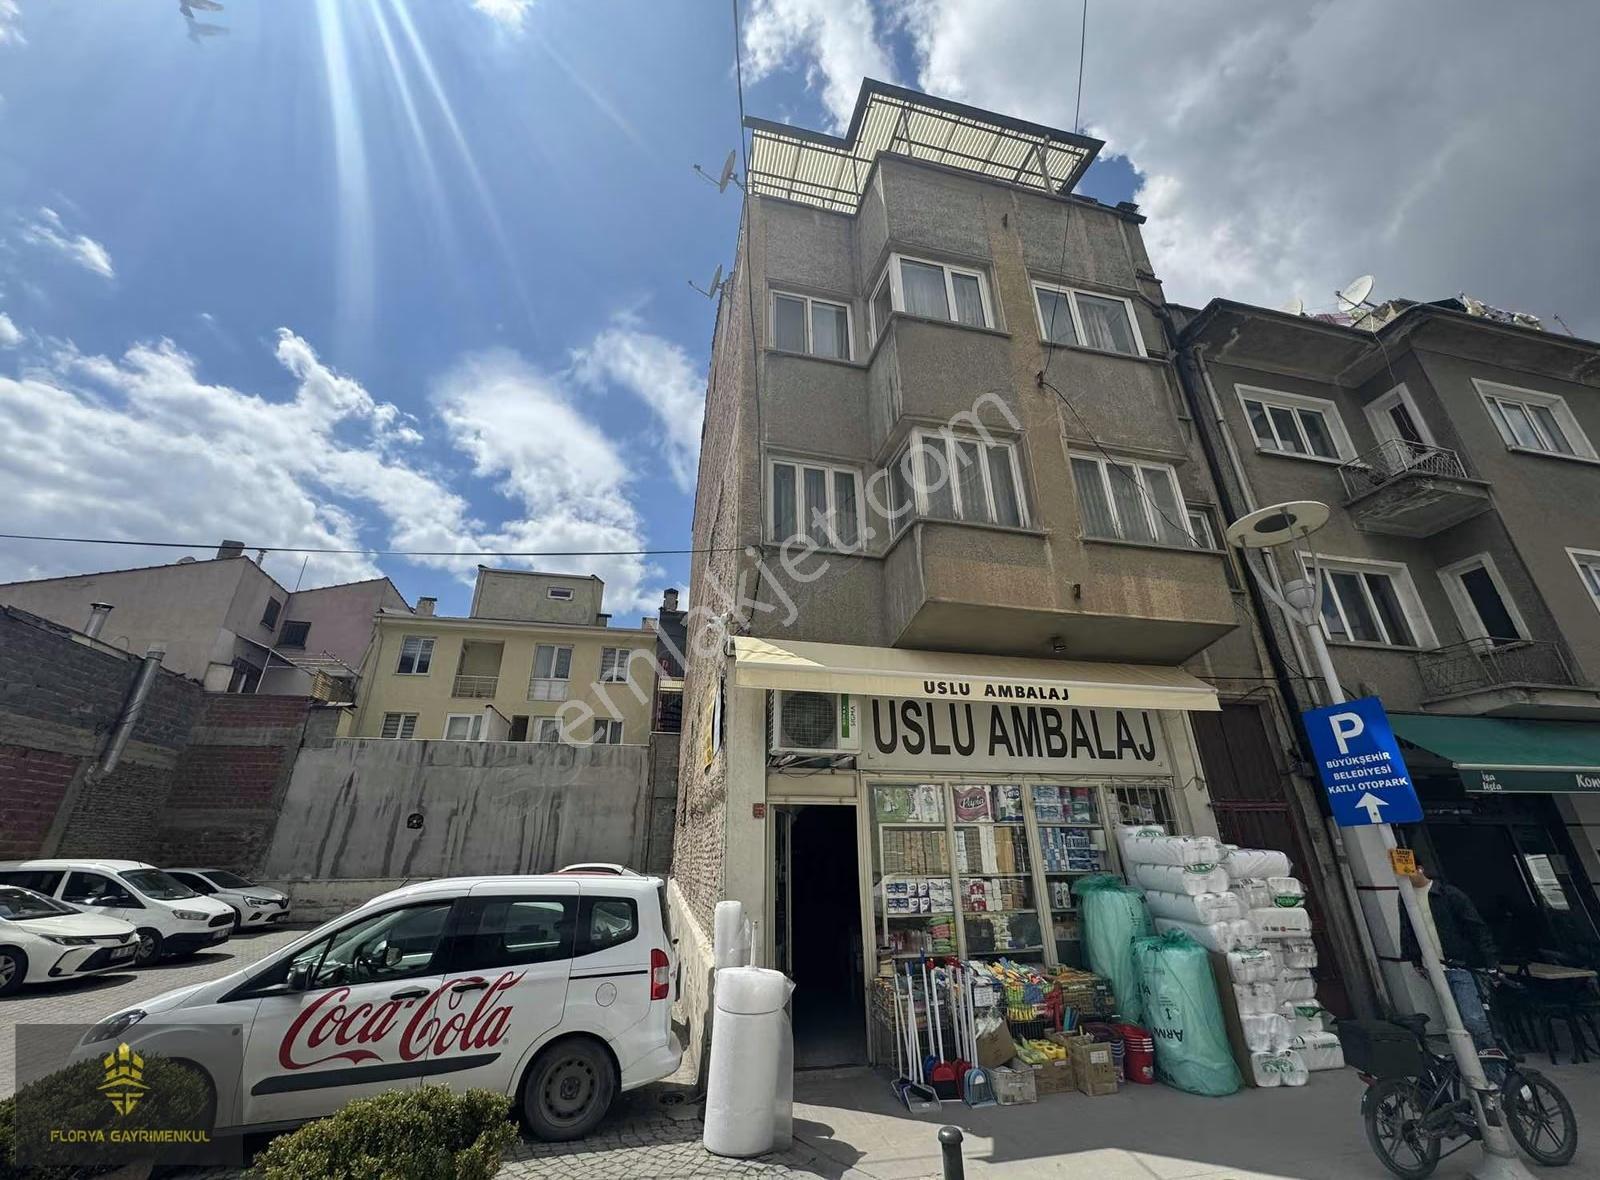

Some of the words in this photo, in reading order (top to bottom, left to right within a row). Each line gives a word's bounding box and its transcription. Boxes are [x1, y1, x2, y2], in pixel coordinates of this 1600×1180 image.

[923, 680, 971, 697] USLU
[984, 683, 1070, 702] AMBALAJ
[872, 699, 976, 756] USLU
[988, 705, 1156, 762] AMBALAJ
[1328, 711, 1365, 755] P
[1326, 750, 1392, 769] BÜYÜKŞEHİR
[1333, 763, 1393, 781] BELEDİYESİ
[1328, 783, 1356, 794] KATLI
[1358, 776, 1409, 790] OTOPARK
